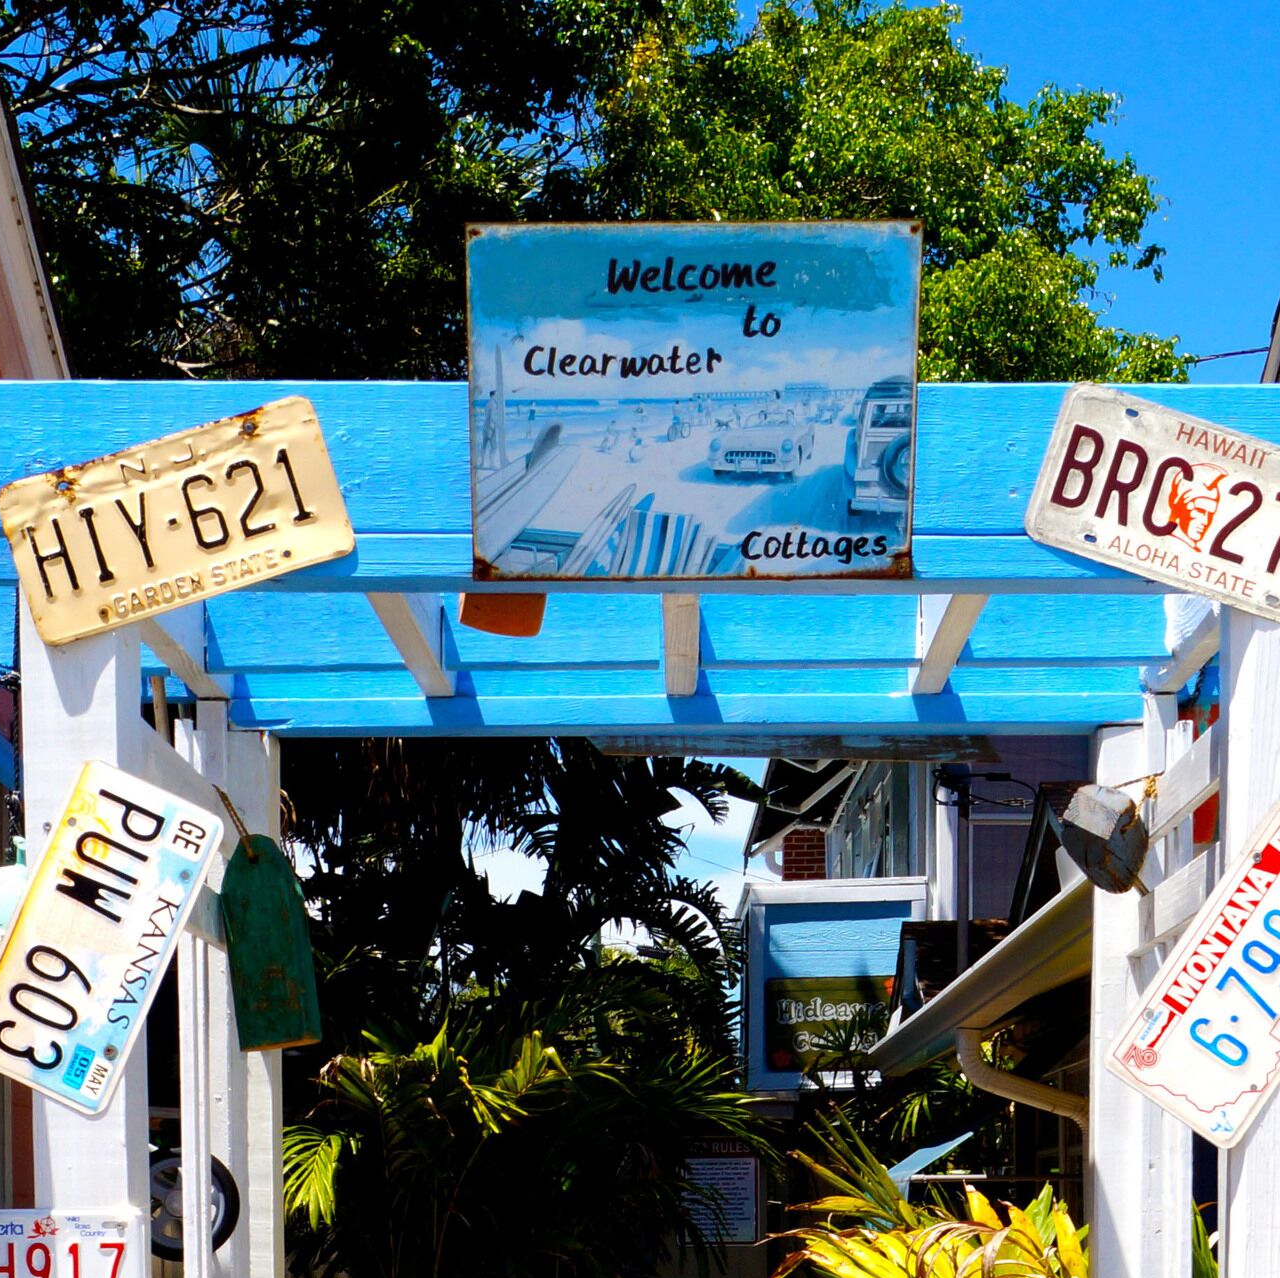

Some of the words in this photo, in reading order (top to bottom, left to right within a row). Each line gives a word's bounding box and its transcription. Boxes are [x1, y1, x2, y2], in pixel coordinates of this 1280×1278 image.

[607, 256, 778, 295] Welcome
[742, 305, 781, 338] to
[523, 345, 722, 379] Clearwater
[1175, 421, 1270, 470] HAWAII
[740, 529, 889, 565] Cottages
[113, 574, 204, 620] GARDEN
[211, 549, 279, 585] STATE
[1107, 534, 1182, 571] ALOHA
[1187, 561, 1257, 599] STATE
[172, 820, 206, 854] GE
[54, 788, 166, 924] PUW
[1166, 866, 1277, 1006] MONTANA
[106, 895, 181, 1031] KANSAS
[74, 1057, 90, 1080] 05
[85, 1063, 109, 1096] MAY
[711, 1140, 751, 1153] RULES
